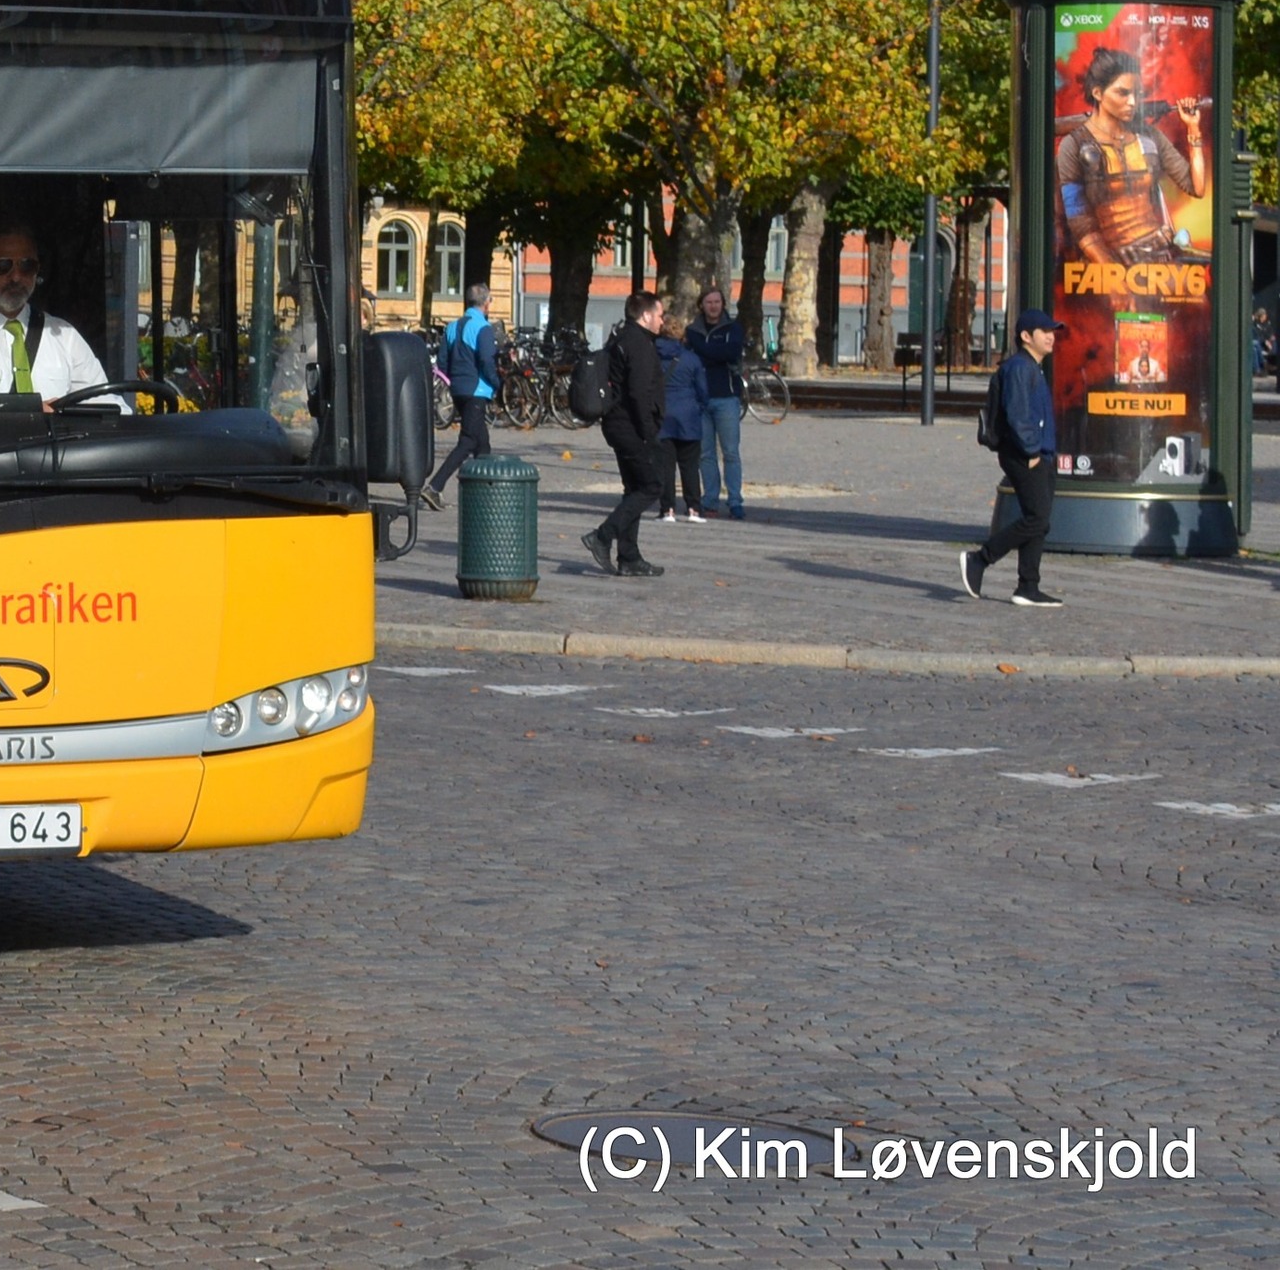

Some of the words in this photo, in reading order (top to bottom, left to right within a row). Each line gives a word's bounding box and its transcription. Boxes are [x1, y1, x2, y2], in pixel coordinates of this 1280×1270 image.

[1074, 15, 1103, 25] XBOX
[1105, 398, 1139, 411] UTE
[1144, 399, 1172, 411] NU!
[1059, 455, 1071, 469] 18
[9, 811, 72, 844] 643
